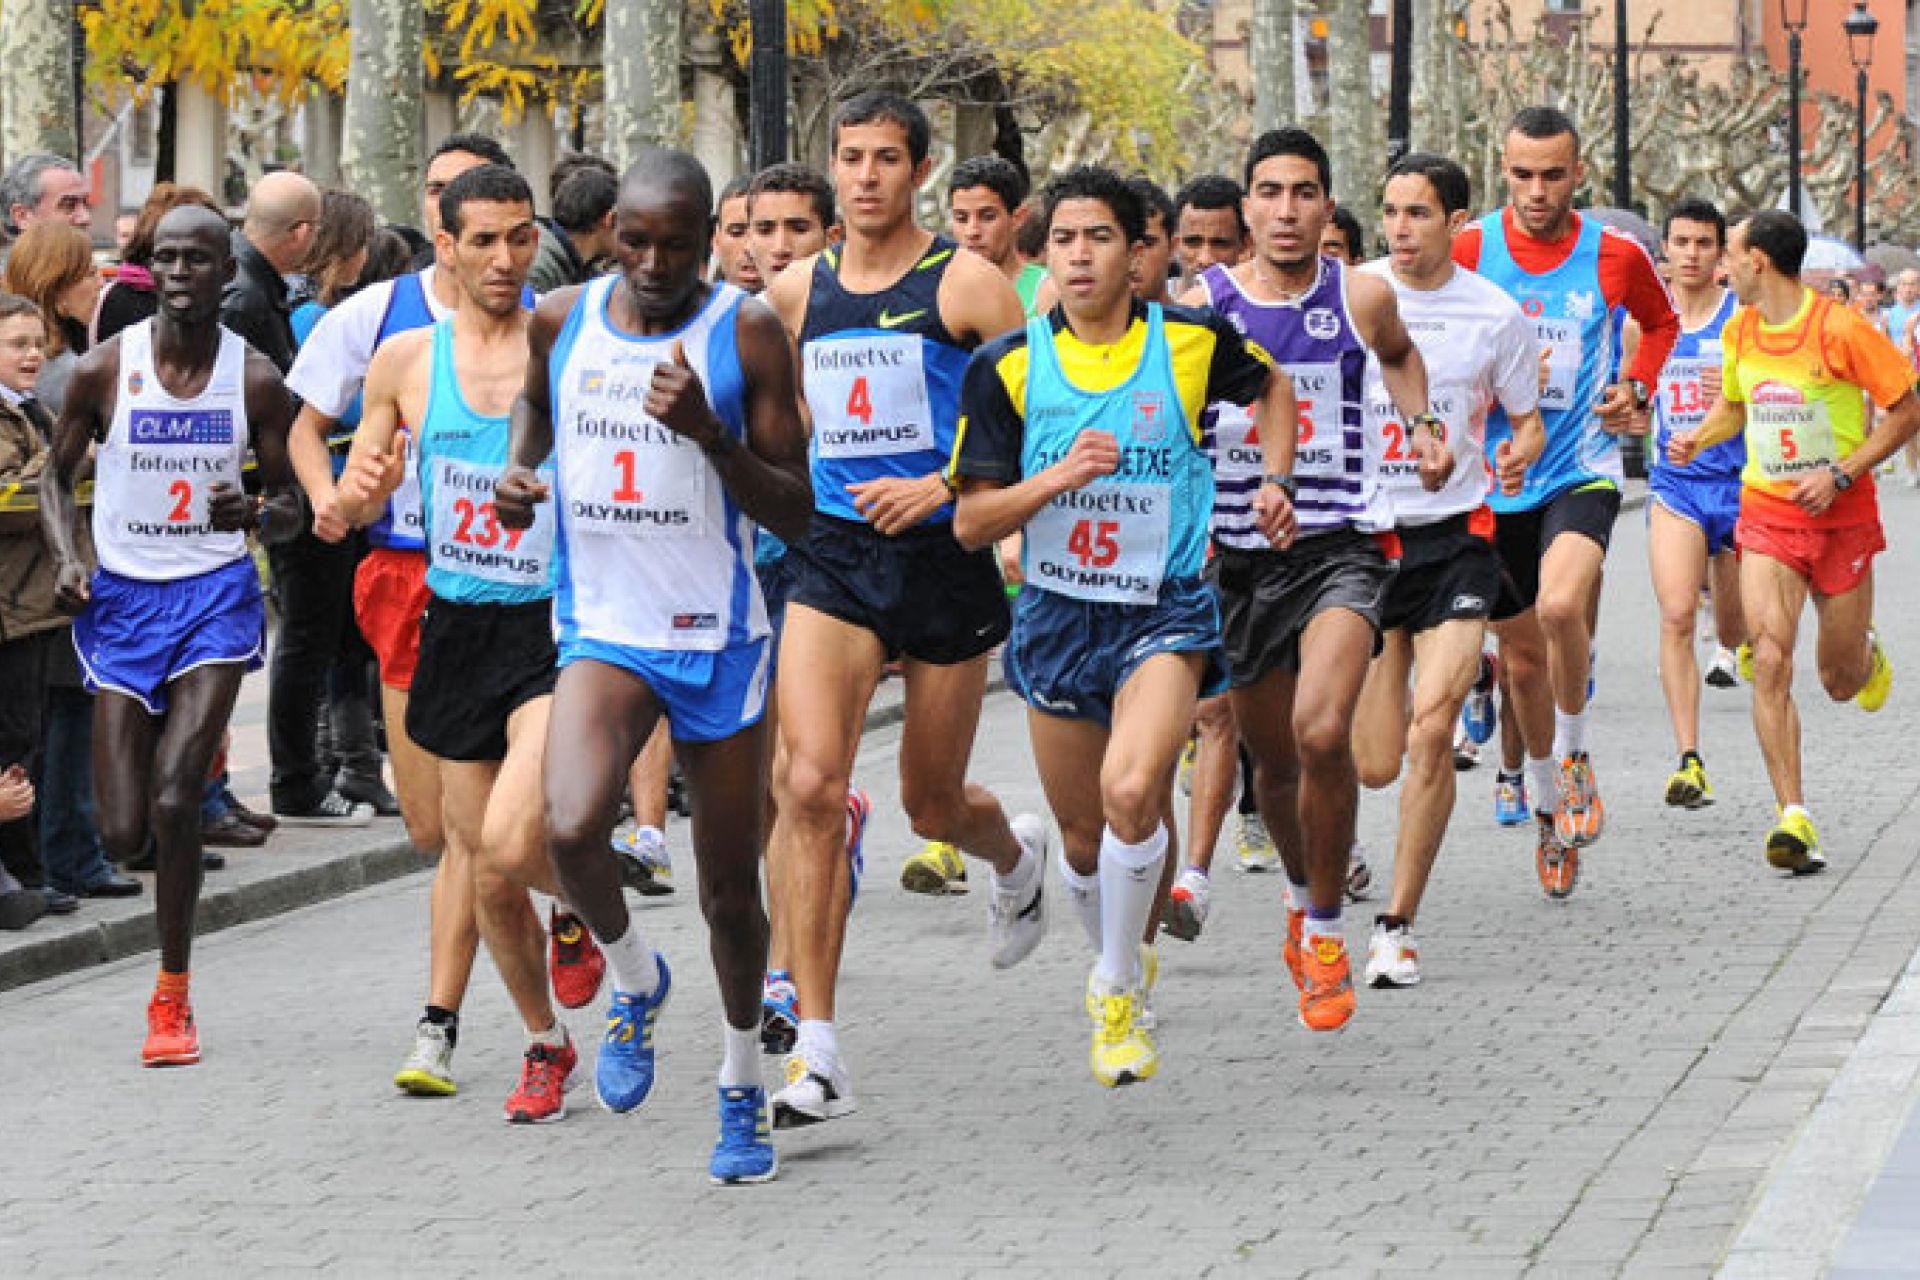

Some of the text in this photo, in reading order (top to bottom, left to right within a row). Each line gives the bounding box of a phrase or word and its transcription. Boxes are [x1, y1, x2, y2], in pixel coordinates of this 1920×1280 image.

[813, 347, 904, 371] fotoetxe
[846, 375, 872, 425] 4
[136, 418, 192, 438] CLM
[823, 424, 920, 444] OLYMPUS
[1780, 428, 1798, 460] 5
[612, 450, 643, 502] 1
[167, 479, 192, 522] 2
[572, 501, 689, 525] OLYMPUS
[1049, 490, 1152, 515] otoetxe
[127, 522, 214, 536] OLYMPU
[1068, 519, 1121, 568] 45
[440, 543, 539, 574] OLYMPUS
[1039, 561, 1150, 591] OLYMPUS
